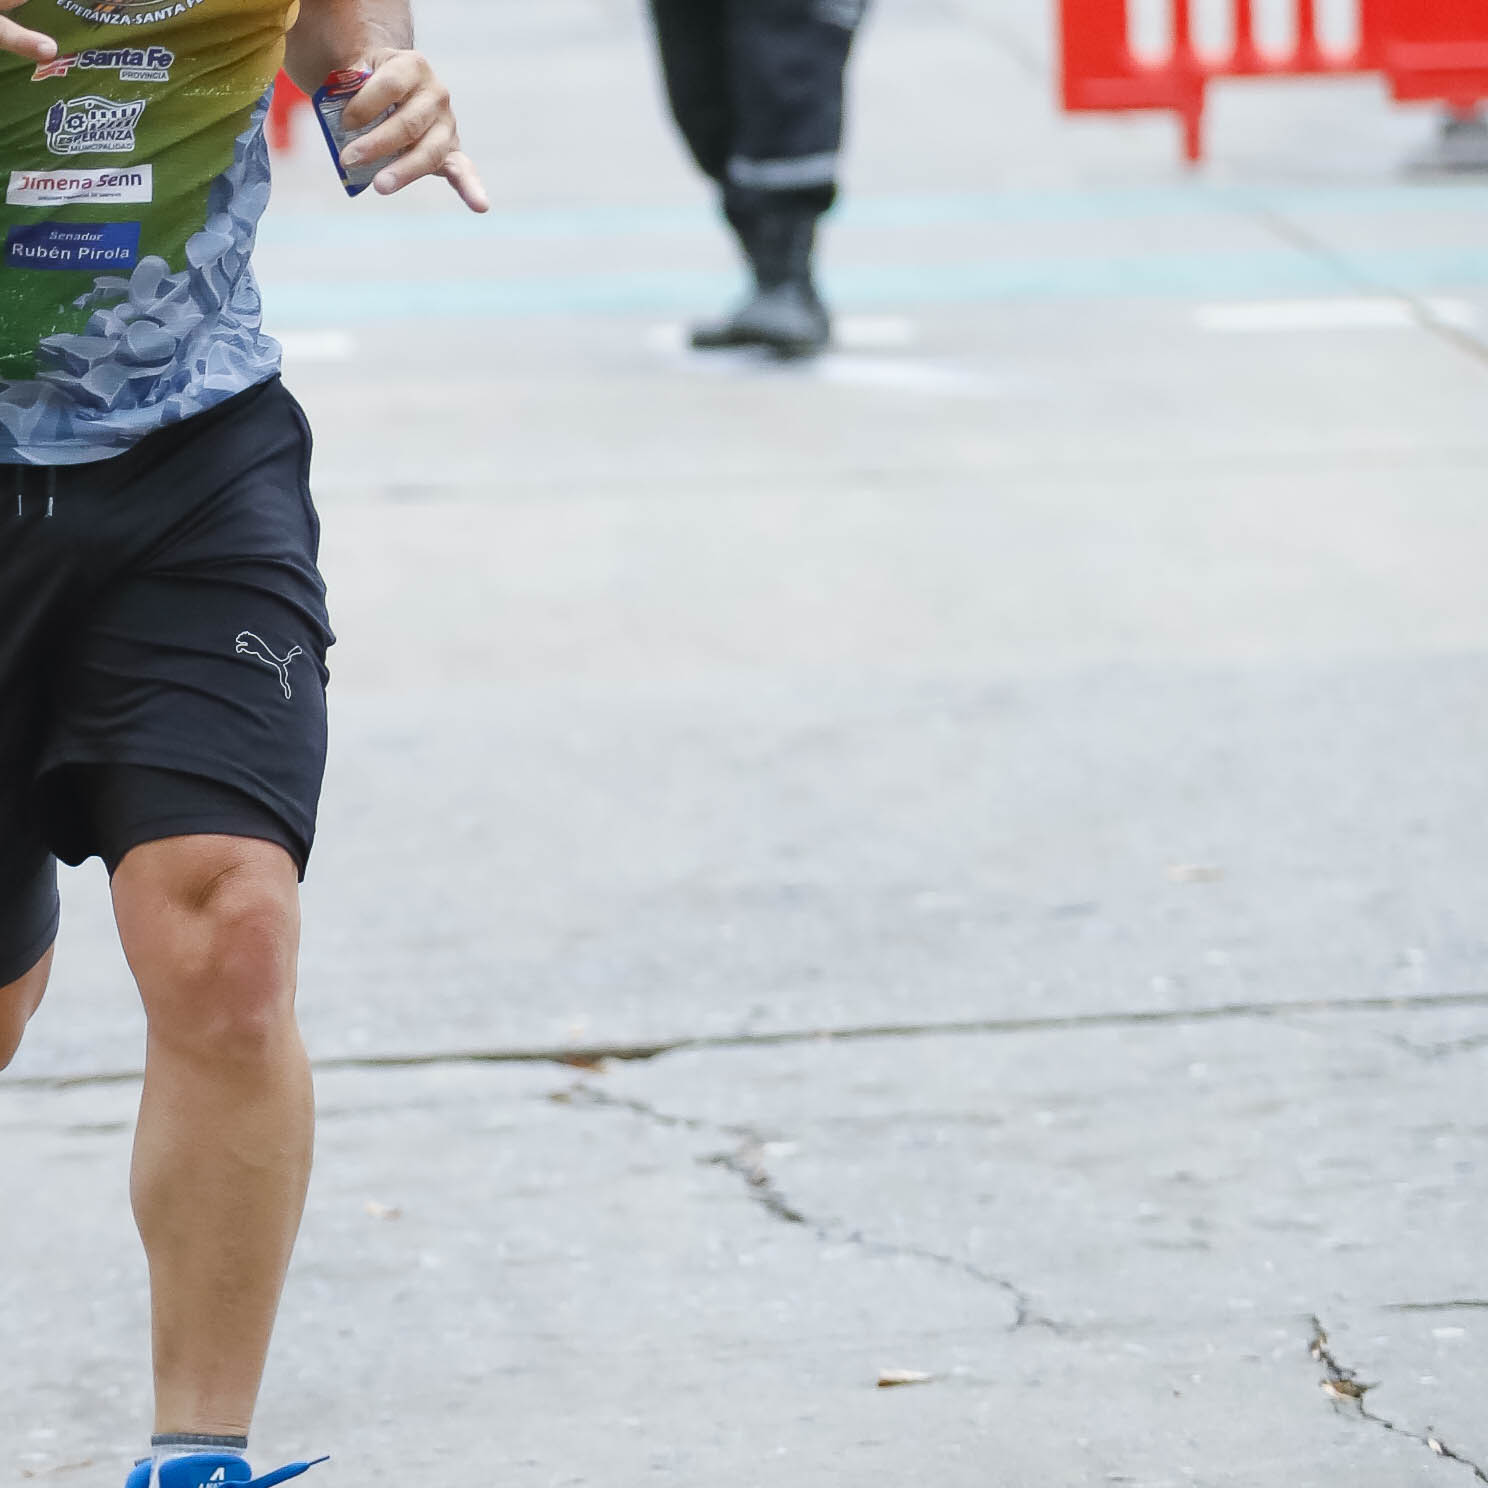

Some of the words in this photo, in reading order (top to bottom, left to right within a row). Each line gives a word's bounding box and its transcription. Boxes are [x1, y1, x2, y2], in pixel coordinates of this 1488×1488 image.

[79, 49, 144, 67] Santa
[147, 47, 174, 69] Fe
[120, 71, 168, 81] PROVINCIA
[57, 129, 133, 145] ESPERANZA
[17, 175, 93, 192] Jimena
[95, 172, 143, 188] Senn
[48, 230, 104, 242] Senador
[11, 242, 72, 261] Rubén
[77, 246, 130, 260] Pirola
